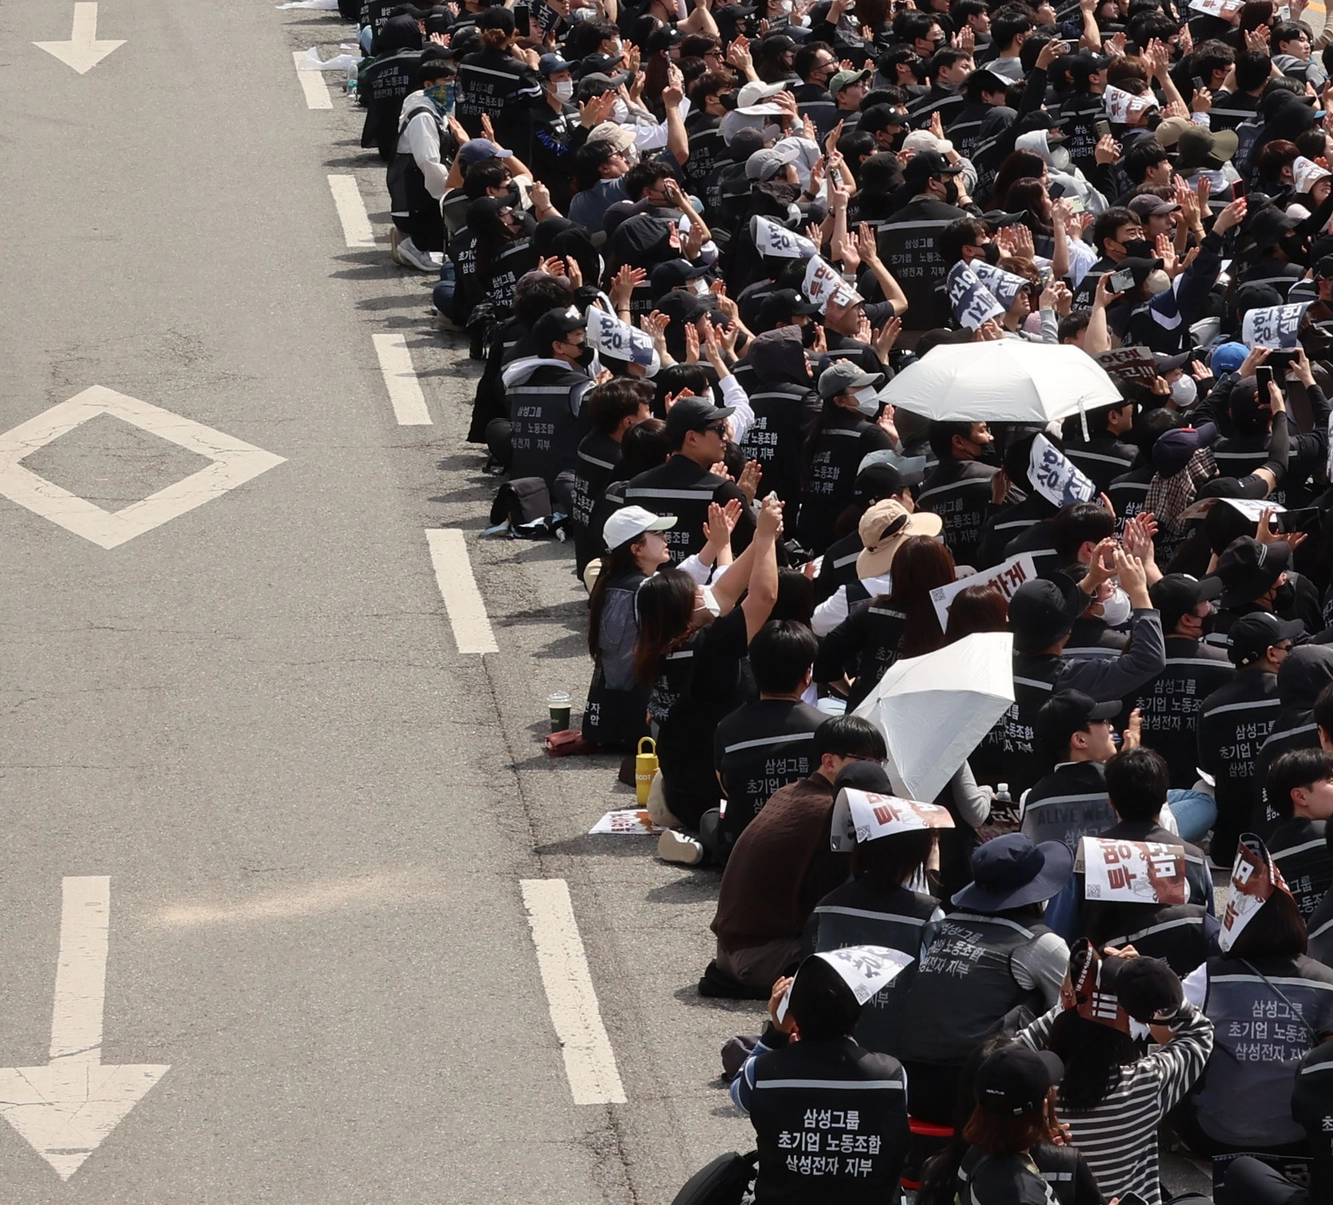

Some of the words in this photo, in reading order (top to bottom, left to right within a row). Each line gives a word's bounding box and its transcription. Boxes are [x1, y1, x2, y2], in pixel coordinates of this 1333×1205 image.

[904, 237, 934, 249] 삼성그룹
[891, 253, 912, 264] 초기업
[747, 431, 778, 446] 노동조합
[945, 514, 980, 528] 노동조합
[1154, 678, 1197, 695] 삼성그룹
[1135, 697, 1166, 712] 초기업
[1141, 715, 1179, 731] 삼성전자
[765, 757, 809, 775] 삼성그룹
[746, 779, 781, 795] 초기업
[940, 923, 984, 945] 삼성그룹
[941, 940, 986, 963] 노동조합
[945, 959, 971, 976] 지부
[1251, 1000, 1303, 1021] 삼성그룹
[1228, 1021, 1268, 1039] 초기업
[1235, 1043, 1284, 1062] 삼성전자
[803, 1108, 860, 1131] 삼성그룹
[777, 1130, 821, 1154] 초기업
[825, 1132, 882, 1156] 노동조합
[785, 1154, 839, 1178] 삼성전자
[844, 1156, 873, 1179] 지부
